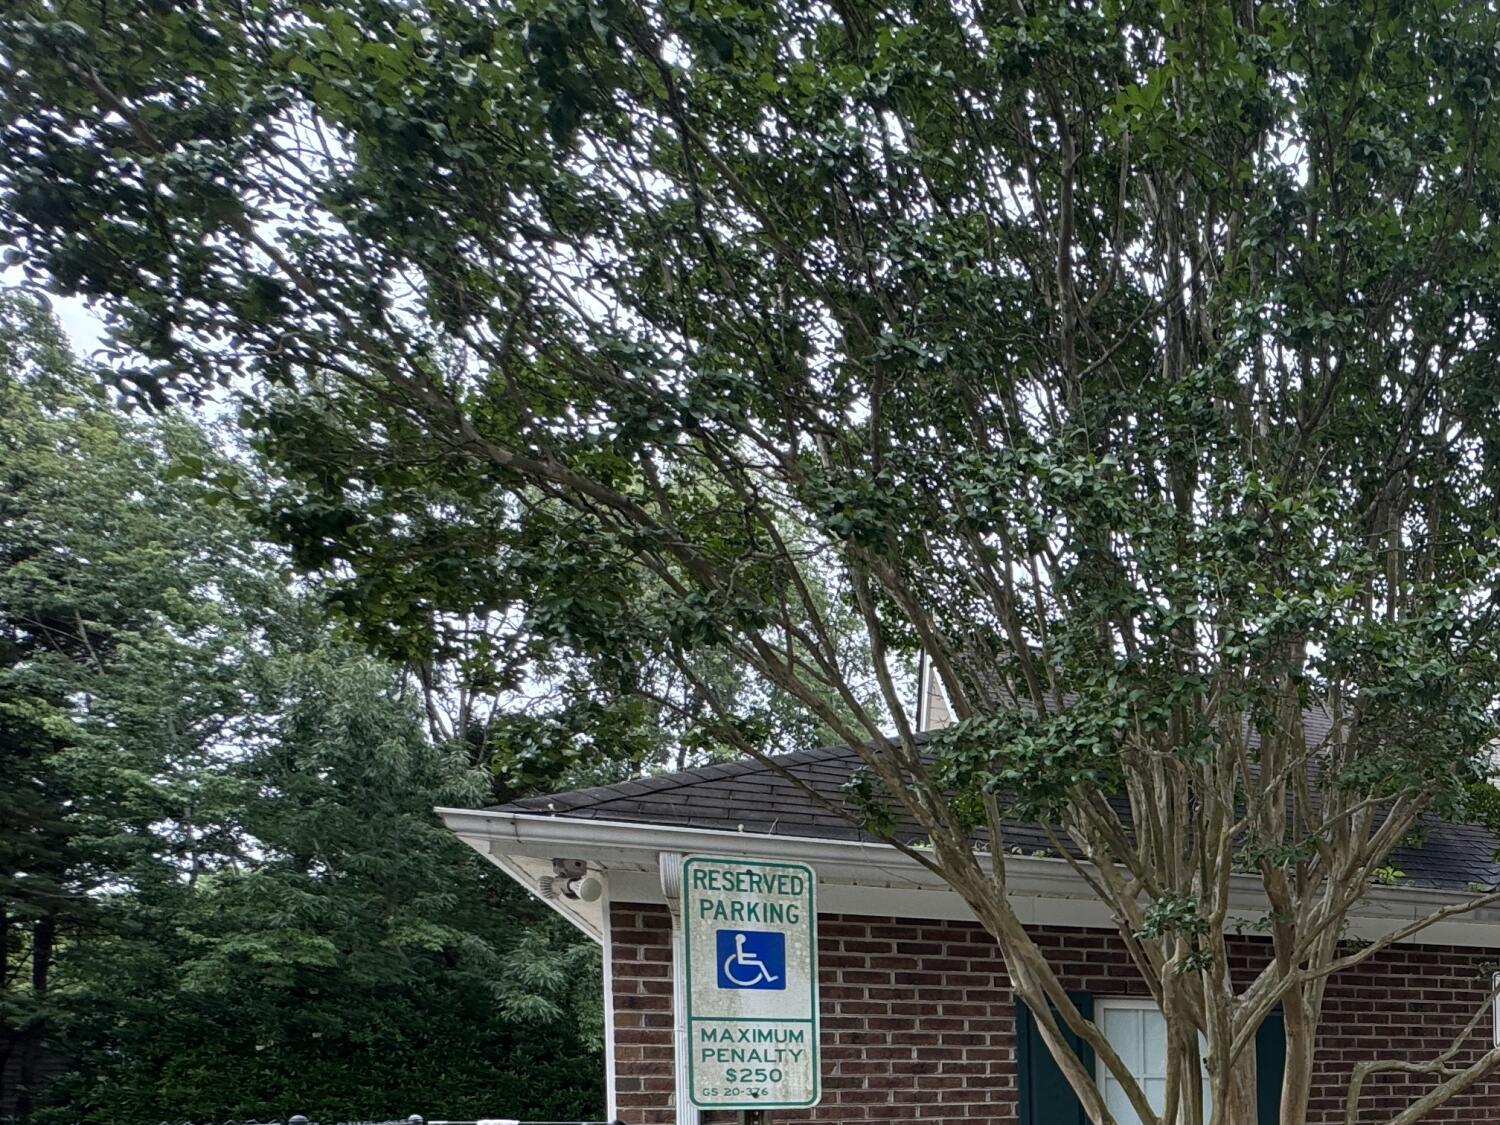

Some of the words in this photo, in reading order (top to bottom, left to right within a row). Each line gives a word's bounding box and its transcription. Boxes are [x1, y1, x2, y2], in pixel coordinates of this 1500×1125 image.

[693, 868, 804, 896] RESERVED
[700, 898, 800, 925] PARKING
[701, 1027, 804, 1043] MAXIMUM
[701, 1048, 803, 1063] PENALTY
[726, 1067, 782, 1083] $250
[702, 1087, 719, 1096] GS
